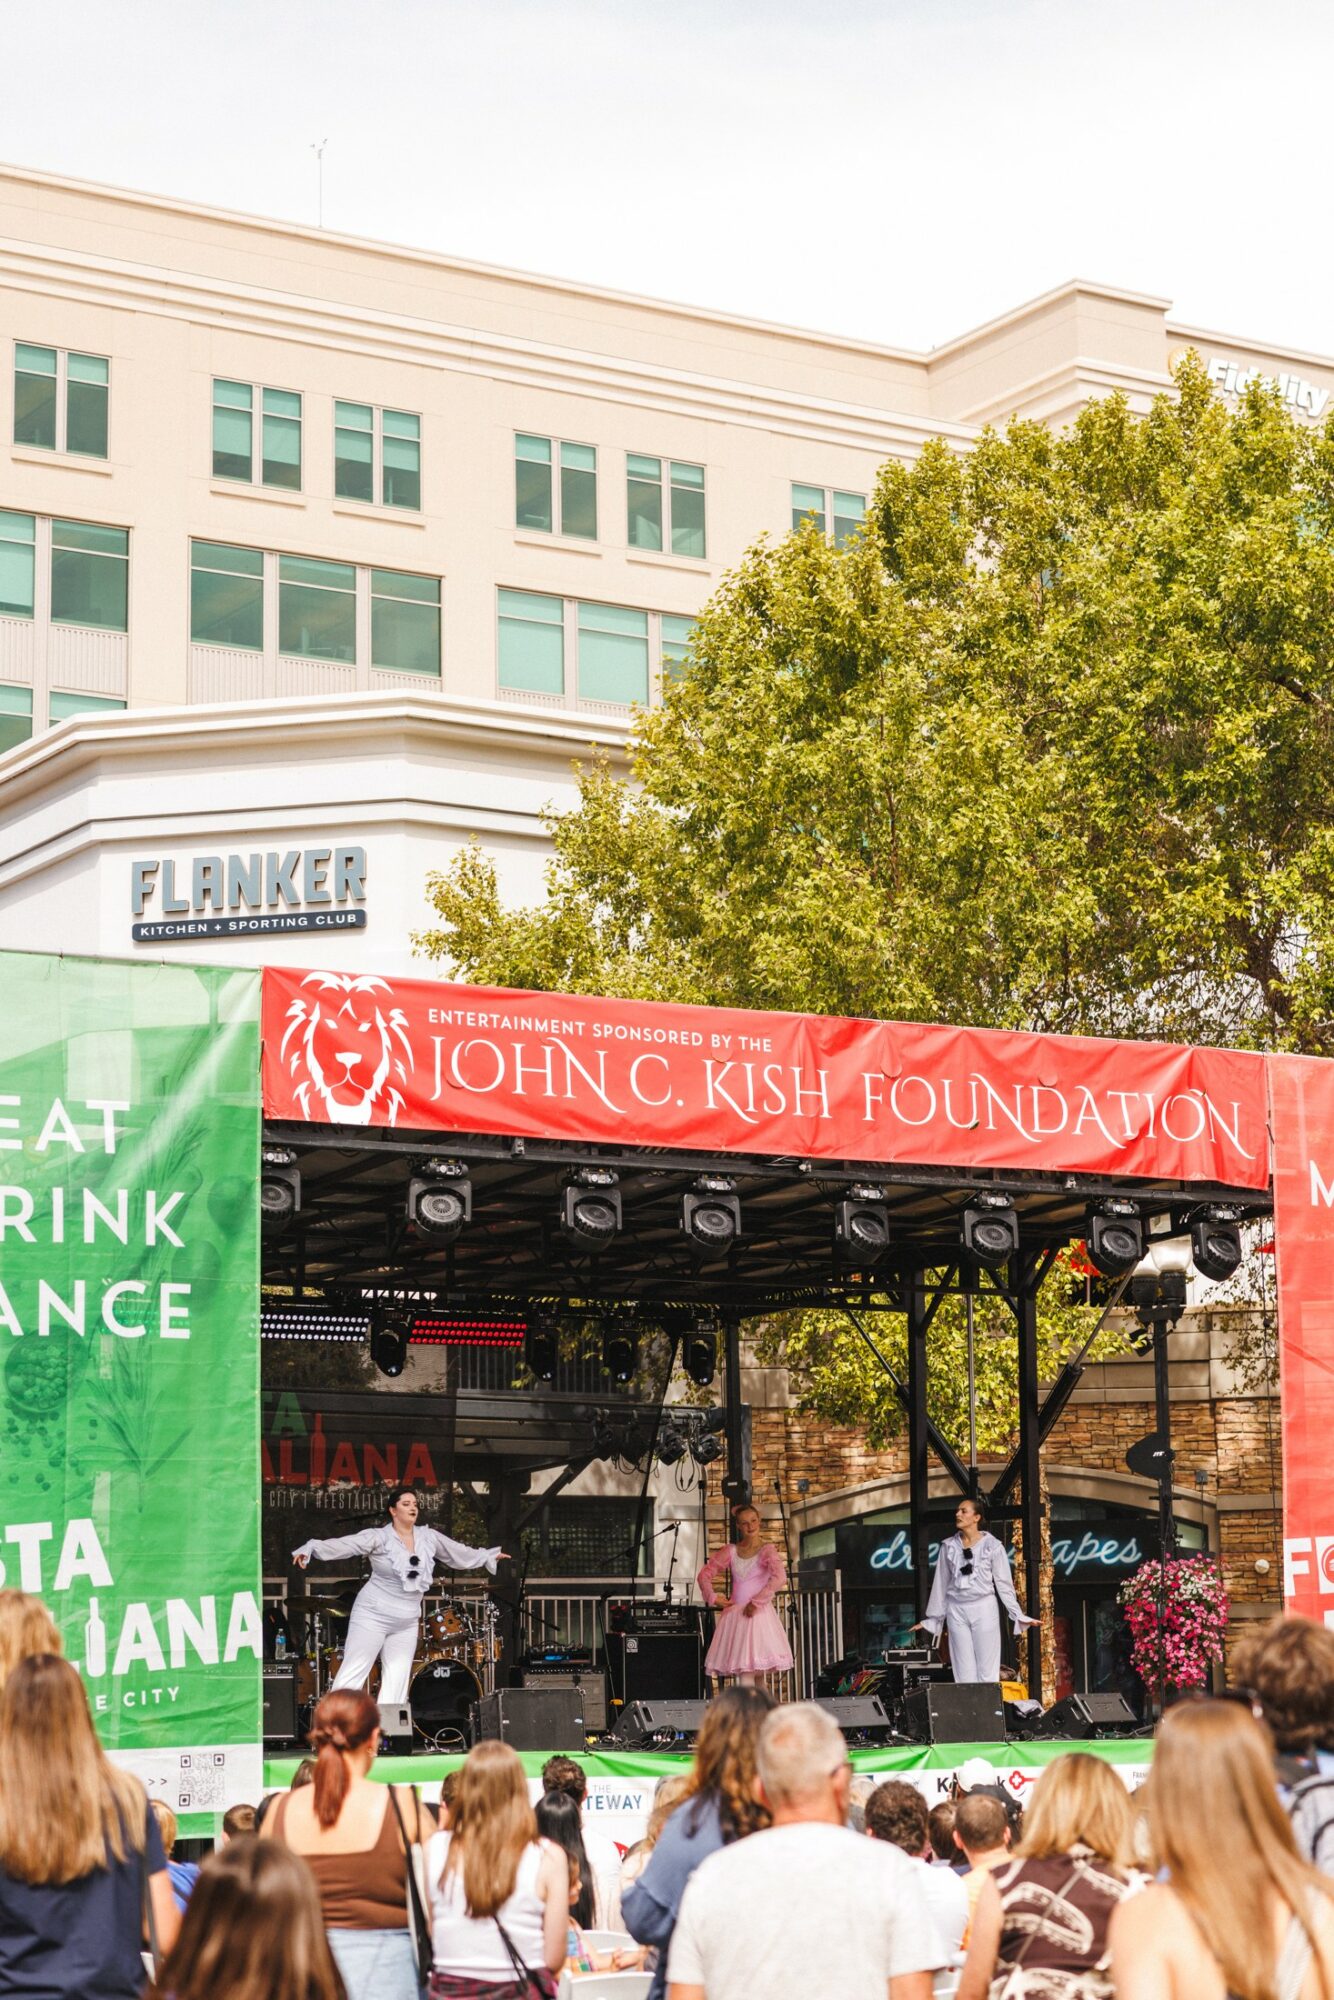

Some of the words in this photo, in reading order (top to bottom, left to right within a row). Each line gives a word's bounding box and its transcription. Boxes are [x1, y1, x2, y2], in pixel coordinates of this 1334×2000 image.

[131, 846, 367, 914] FLANKER
[140, 923, 208, 937] KITCHEN
[228, 916, 309, 931] SPORTING
[315, 913, 358, 926] CLUB
[428, 1008, 586, 1037] ENTERTAINMENT
[592, 1023, 702, 1047] SPONSORED
[711, 1034, 732, 1049] BY
[739, 1036, 772, 1053] THE
[430, 1035, 629, 1114] JOHN
[630, 1053, 685, 1107] C.
[703, 1059, 833, 1124] KISH
[861, 1072, 1256, 1160] FOUNDATION
[0, 1095, 130, 1154] EAT
[0, 1518, 114, 1593] TA
[870, 1531, 1142, 1576] dreapes
[70, 1591, 262, 1678] IANA
[123, 1686, 180, 1707] CITY
[581, 1795, 642, 1810] TEWAY
[593, 1784, 612, 1793] THE
